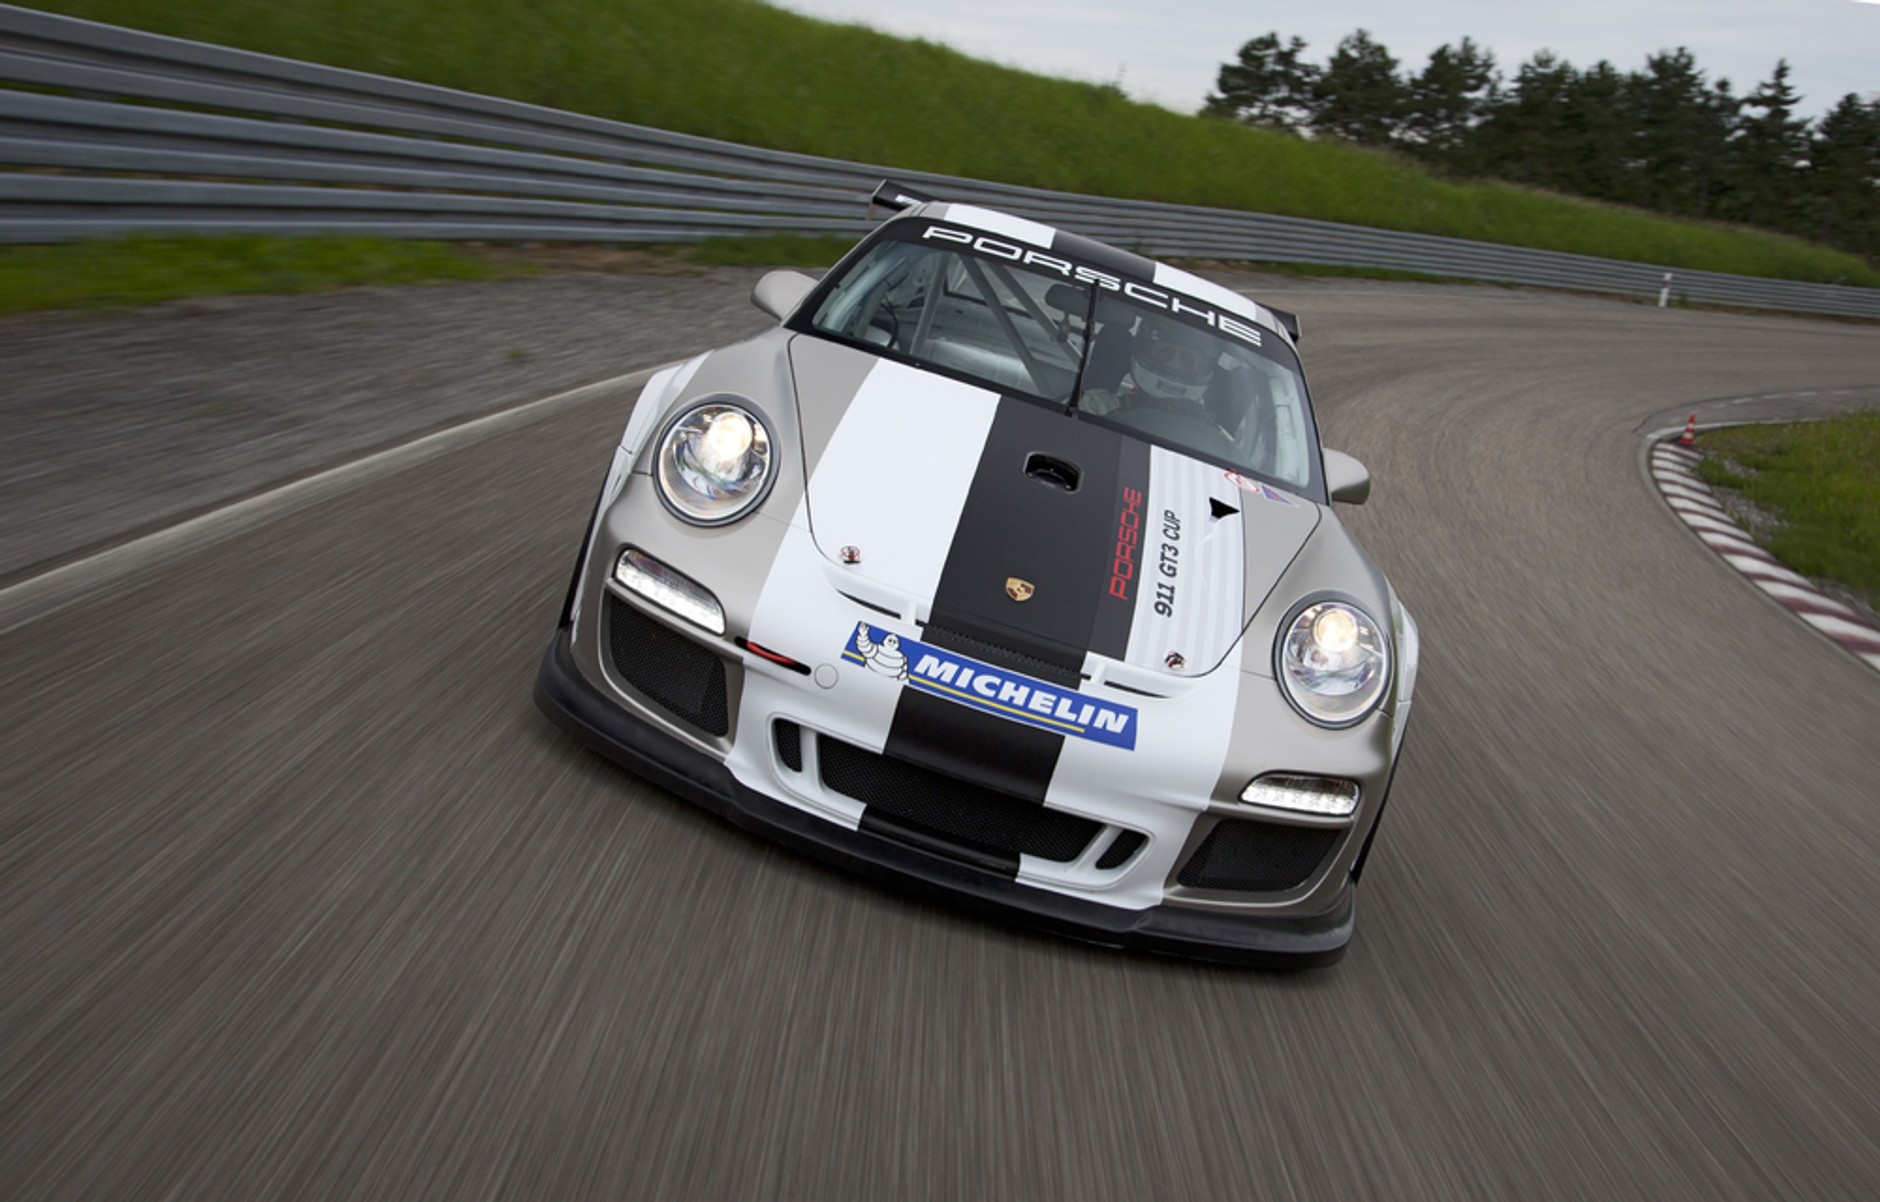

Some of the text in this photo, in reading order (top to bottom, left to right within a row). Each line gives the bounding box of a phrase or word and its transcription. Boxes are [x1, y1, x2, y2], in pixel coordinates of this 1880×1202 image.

[922, 225, 1262, 347] PORSCHE
[1109, 486, 1142, 600] PORSCHE
[1154, 509, 1181, 618] 911 GT3 CUP
[914, 654, 1129, 733] MICHELIN
